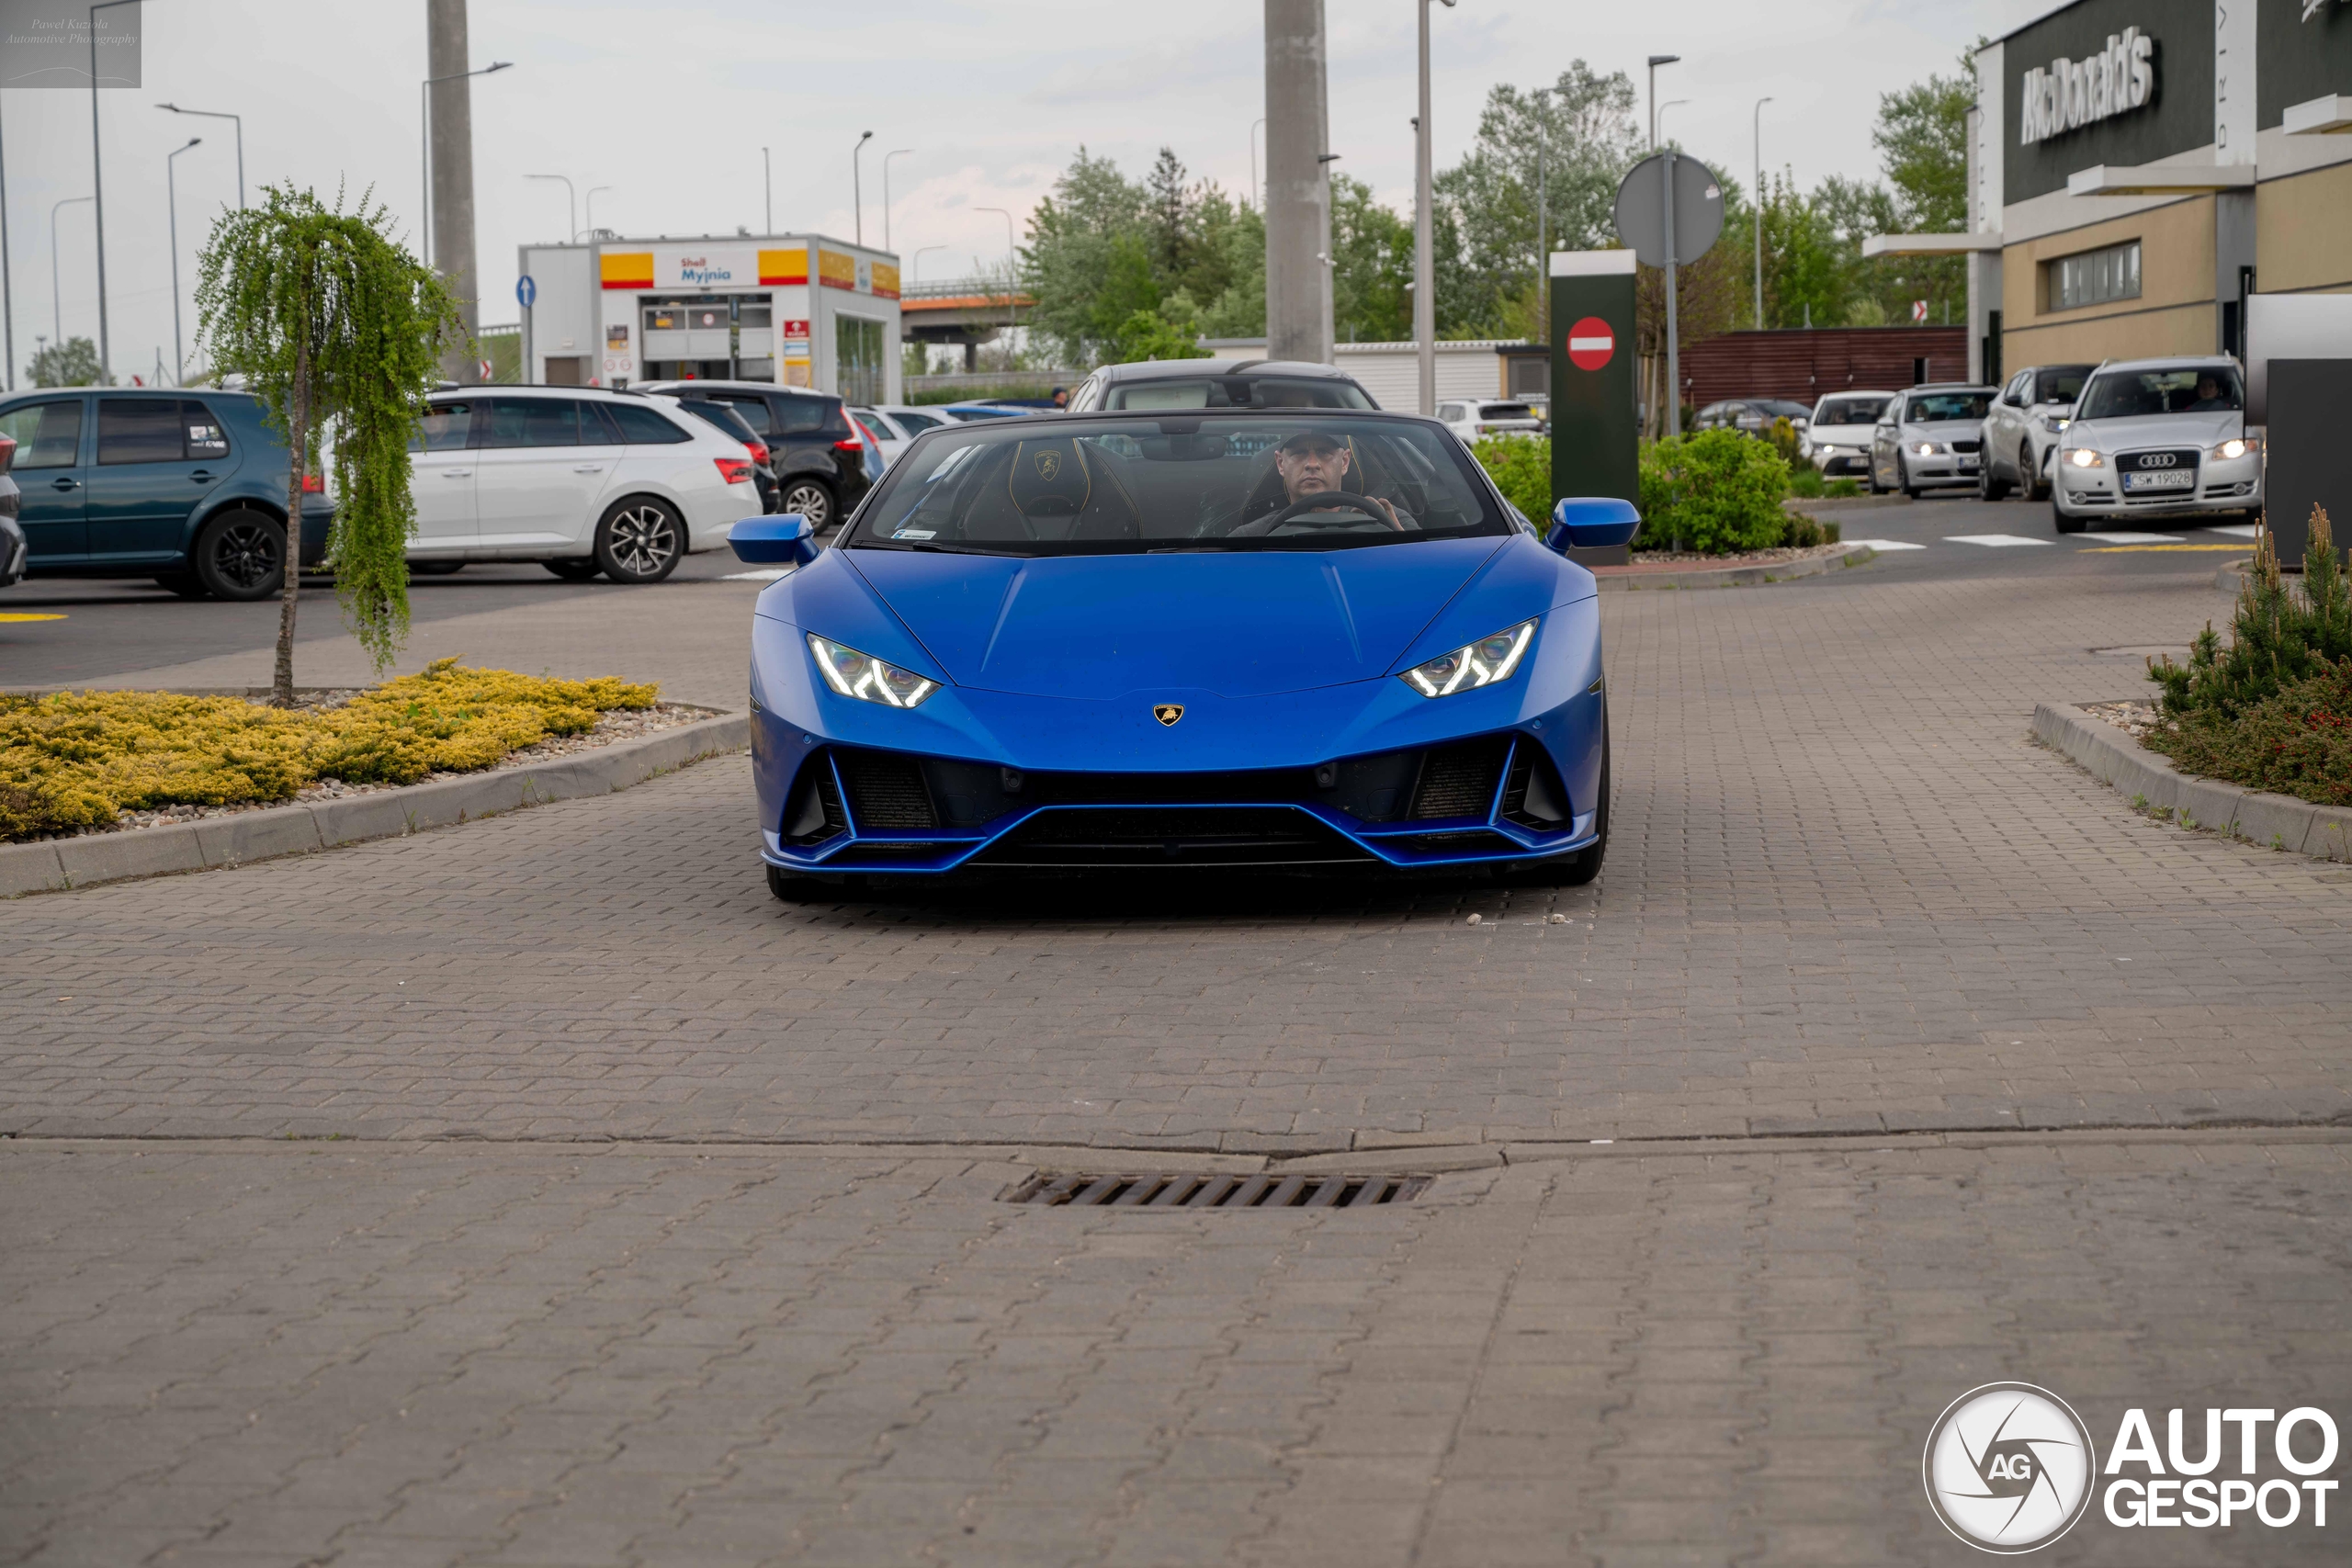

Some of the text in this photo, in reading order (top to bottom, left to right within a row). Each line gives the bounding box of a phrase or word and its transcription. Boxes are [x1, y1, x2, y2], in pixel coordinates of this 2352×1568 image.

[2021, 26, 2154, 145] McDonald's
[681, 256, 707, 267] Shell
[682, 267, 731, 284] Myjnia
[2132, 472, 2191, 486] CSW 19028
